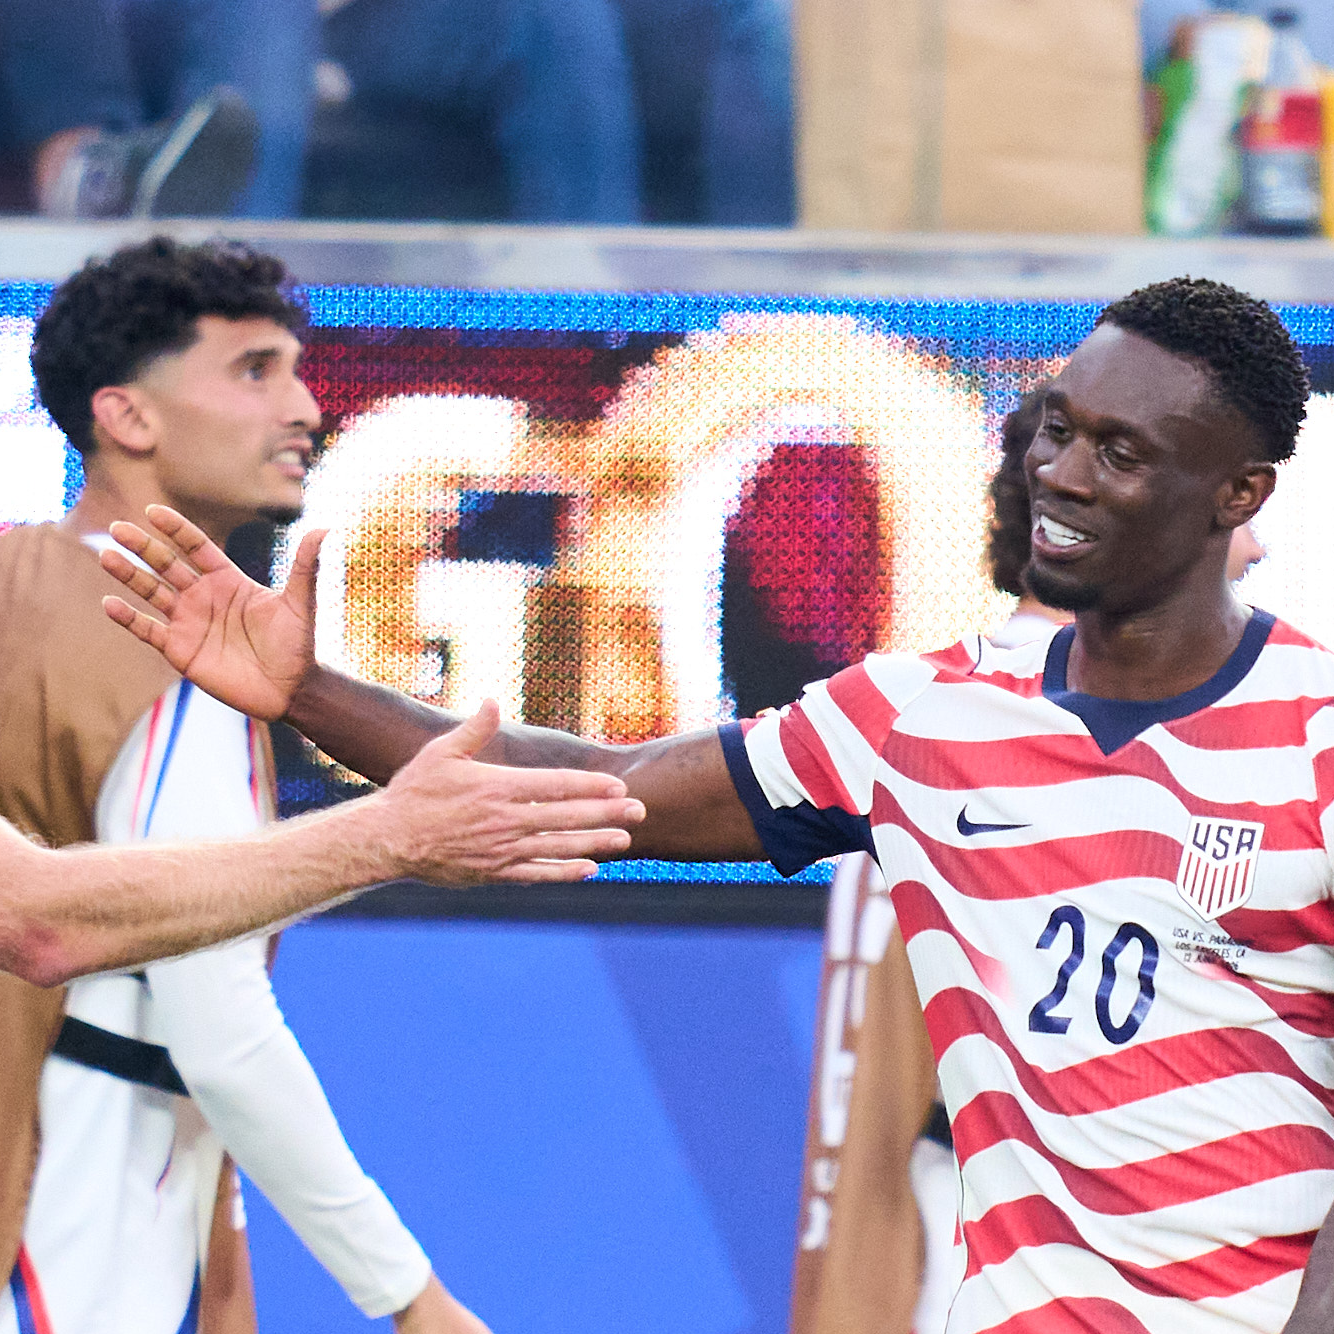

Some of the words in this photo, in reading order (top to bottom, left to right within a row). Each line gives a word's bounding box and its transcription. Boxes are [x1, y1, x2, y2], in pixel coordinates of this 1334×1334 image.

[1192, 822, 1256, 861] USA
[1172, 926, 1189, 939] USA
[1175, 940, 1191, 951] LOS
[1028, 905, 1159, 1046] 20
